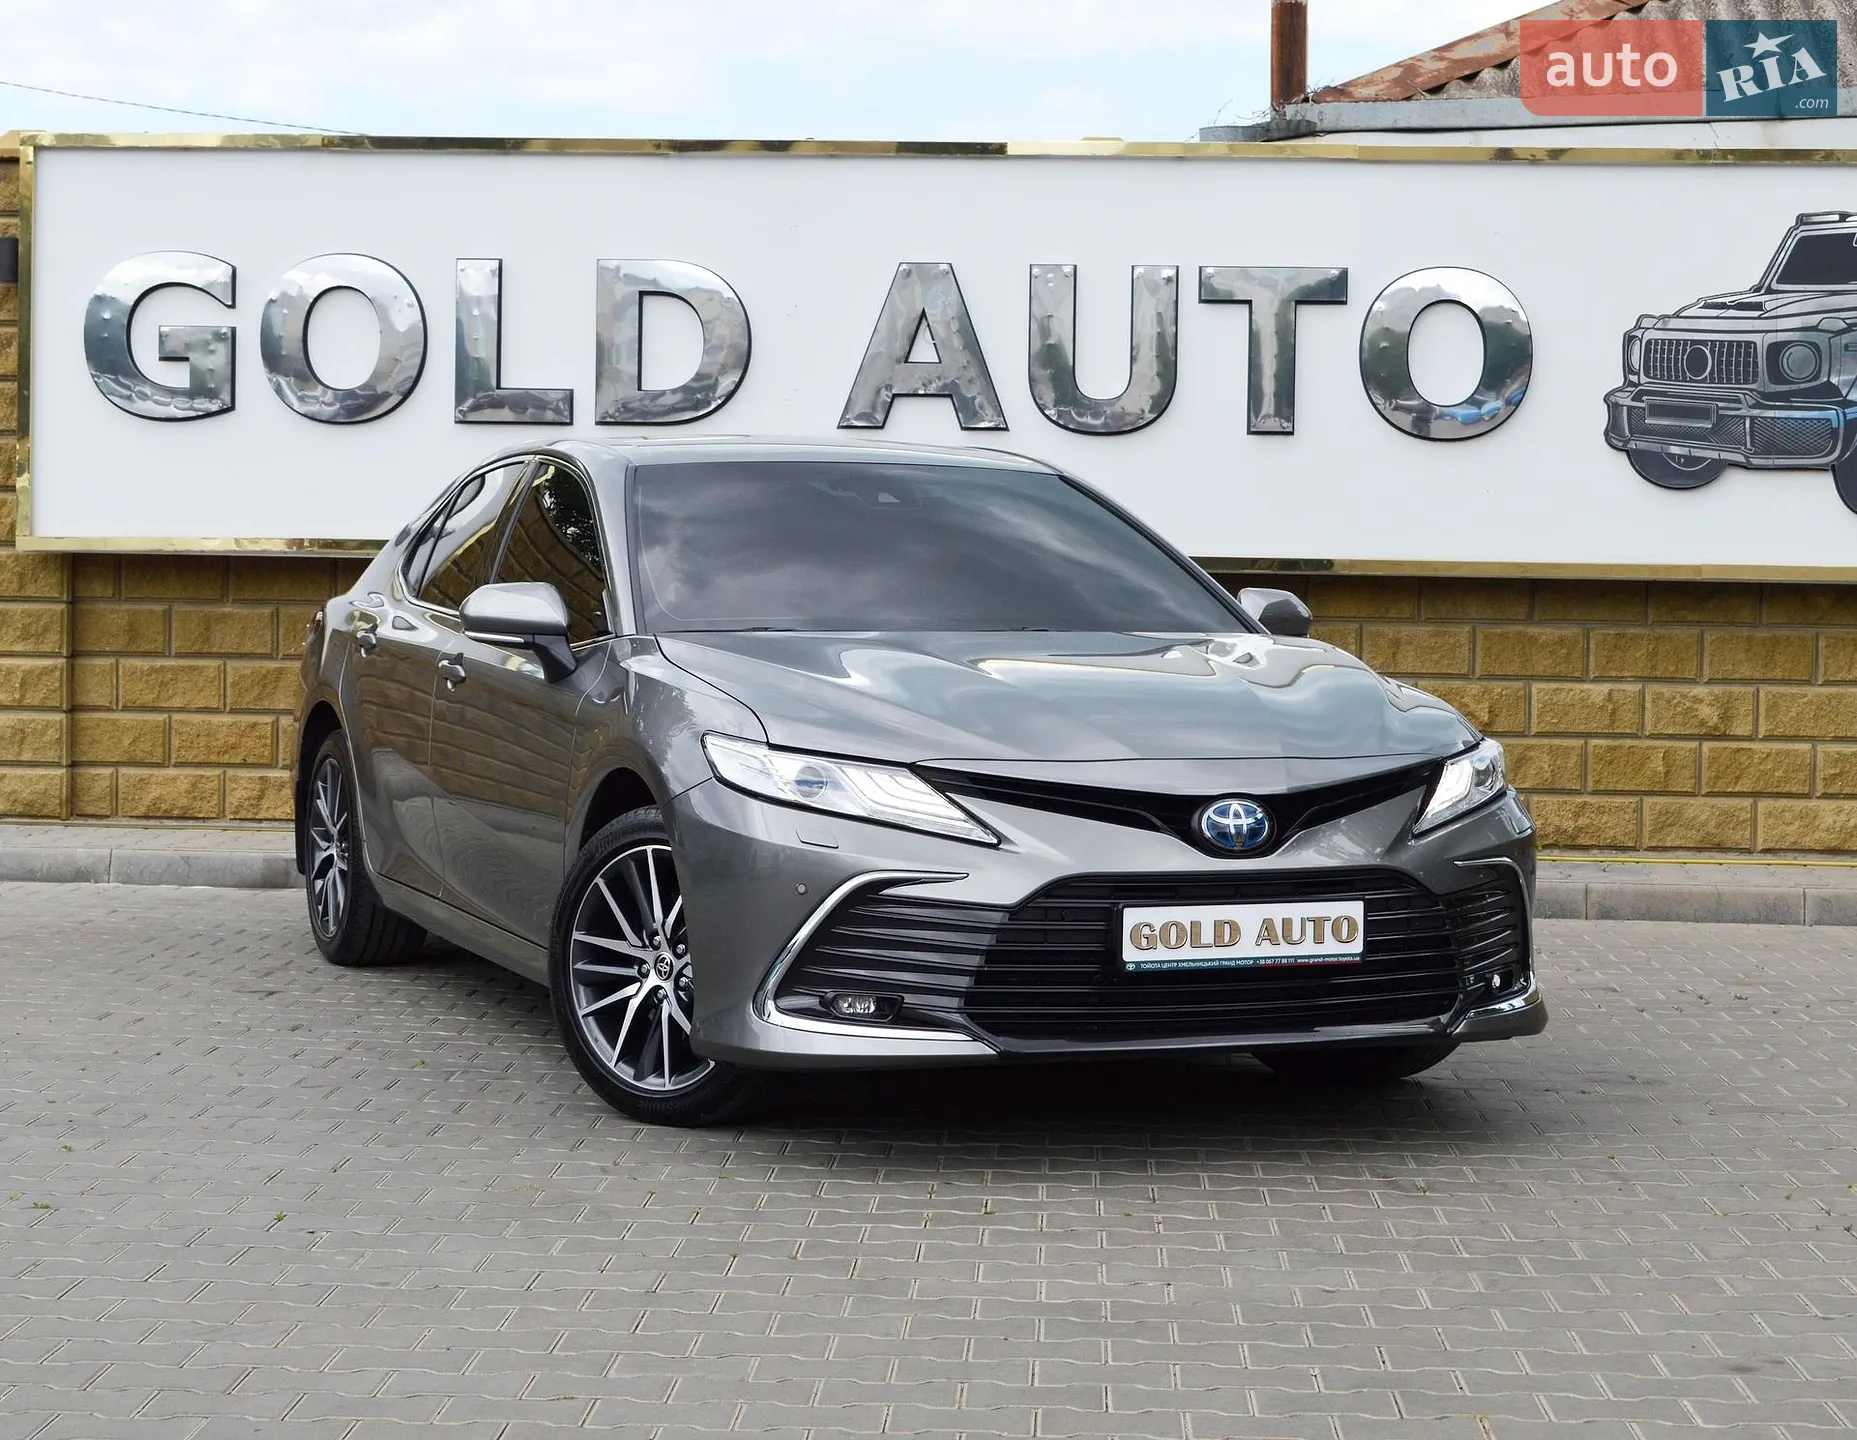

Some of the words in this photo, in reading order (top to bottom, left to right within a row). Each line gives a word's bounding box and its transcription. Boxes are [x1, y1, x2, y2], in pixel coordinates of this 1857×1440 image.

[84, 250, 752, 425] GOLD
[836, 261, 1533, 441] AUTO
[1129, 919, 1242, 951] GOLD
[1255, 915, 1359, 946] AUTO
